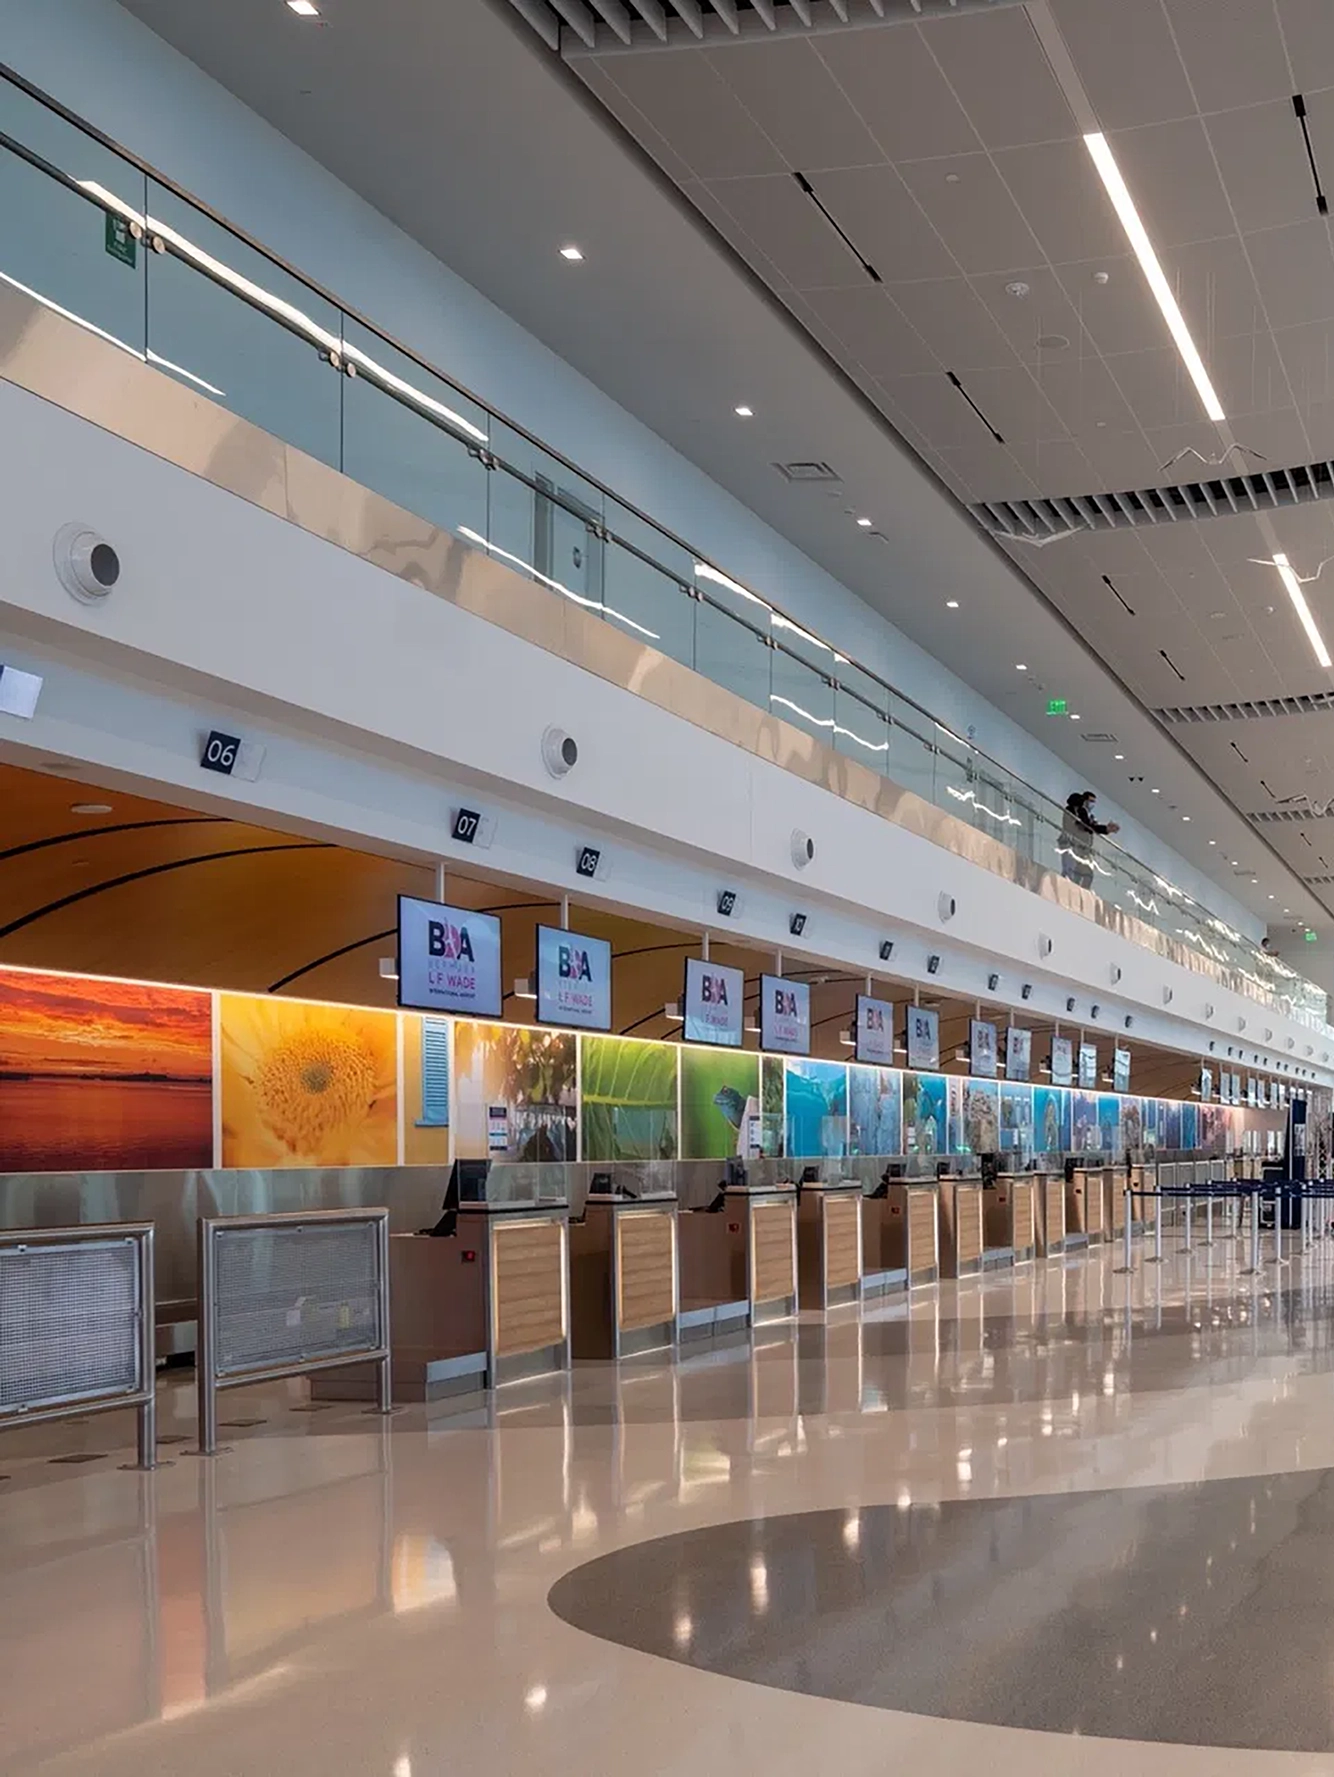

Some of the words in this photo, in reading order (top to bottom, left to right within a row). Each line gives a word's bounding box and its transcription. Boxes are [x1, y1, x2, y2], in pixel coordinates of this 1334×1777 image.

[207, 739, 236, 767] 06
[457, 815, 478, 837] 07
[581, 853, 597, 872] 08
[447, 973, 475, 990] WADE
